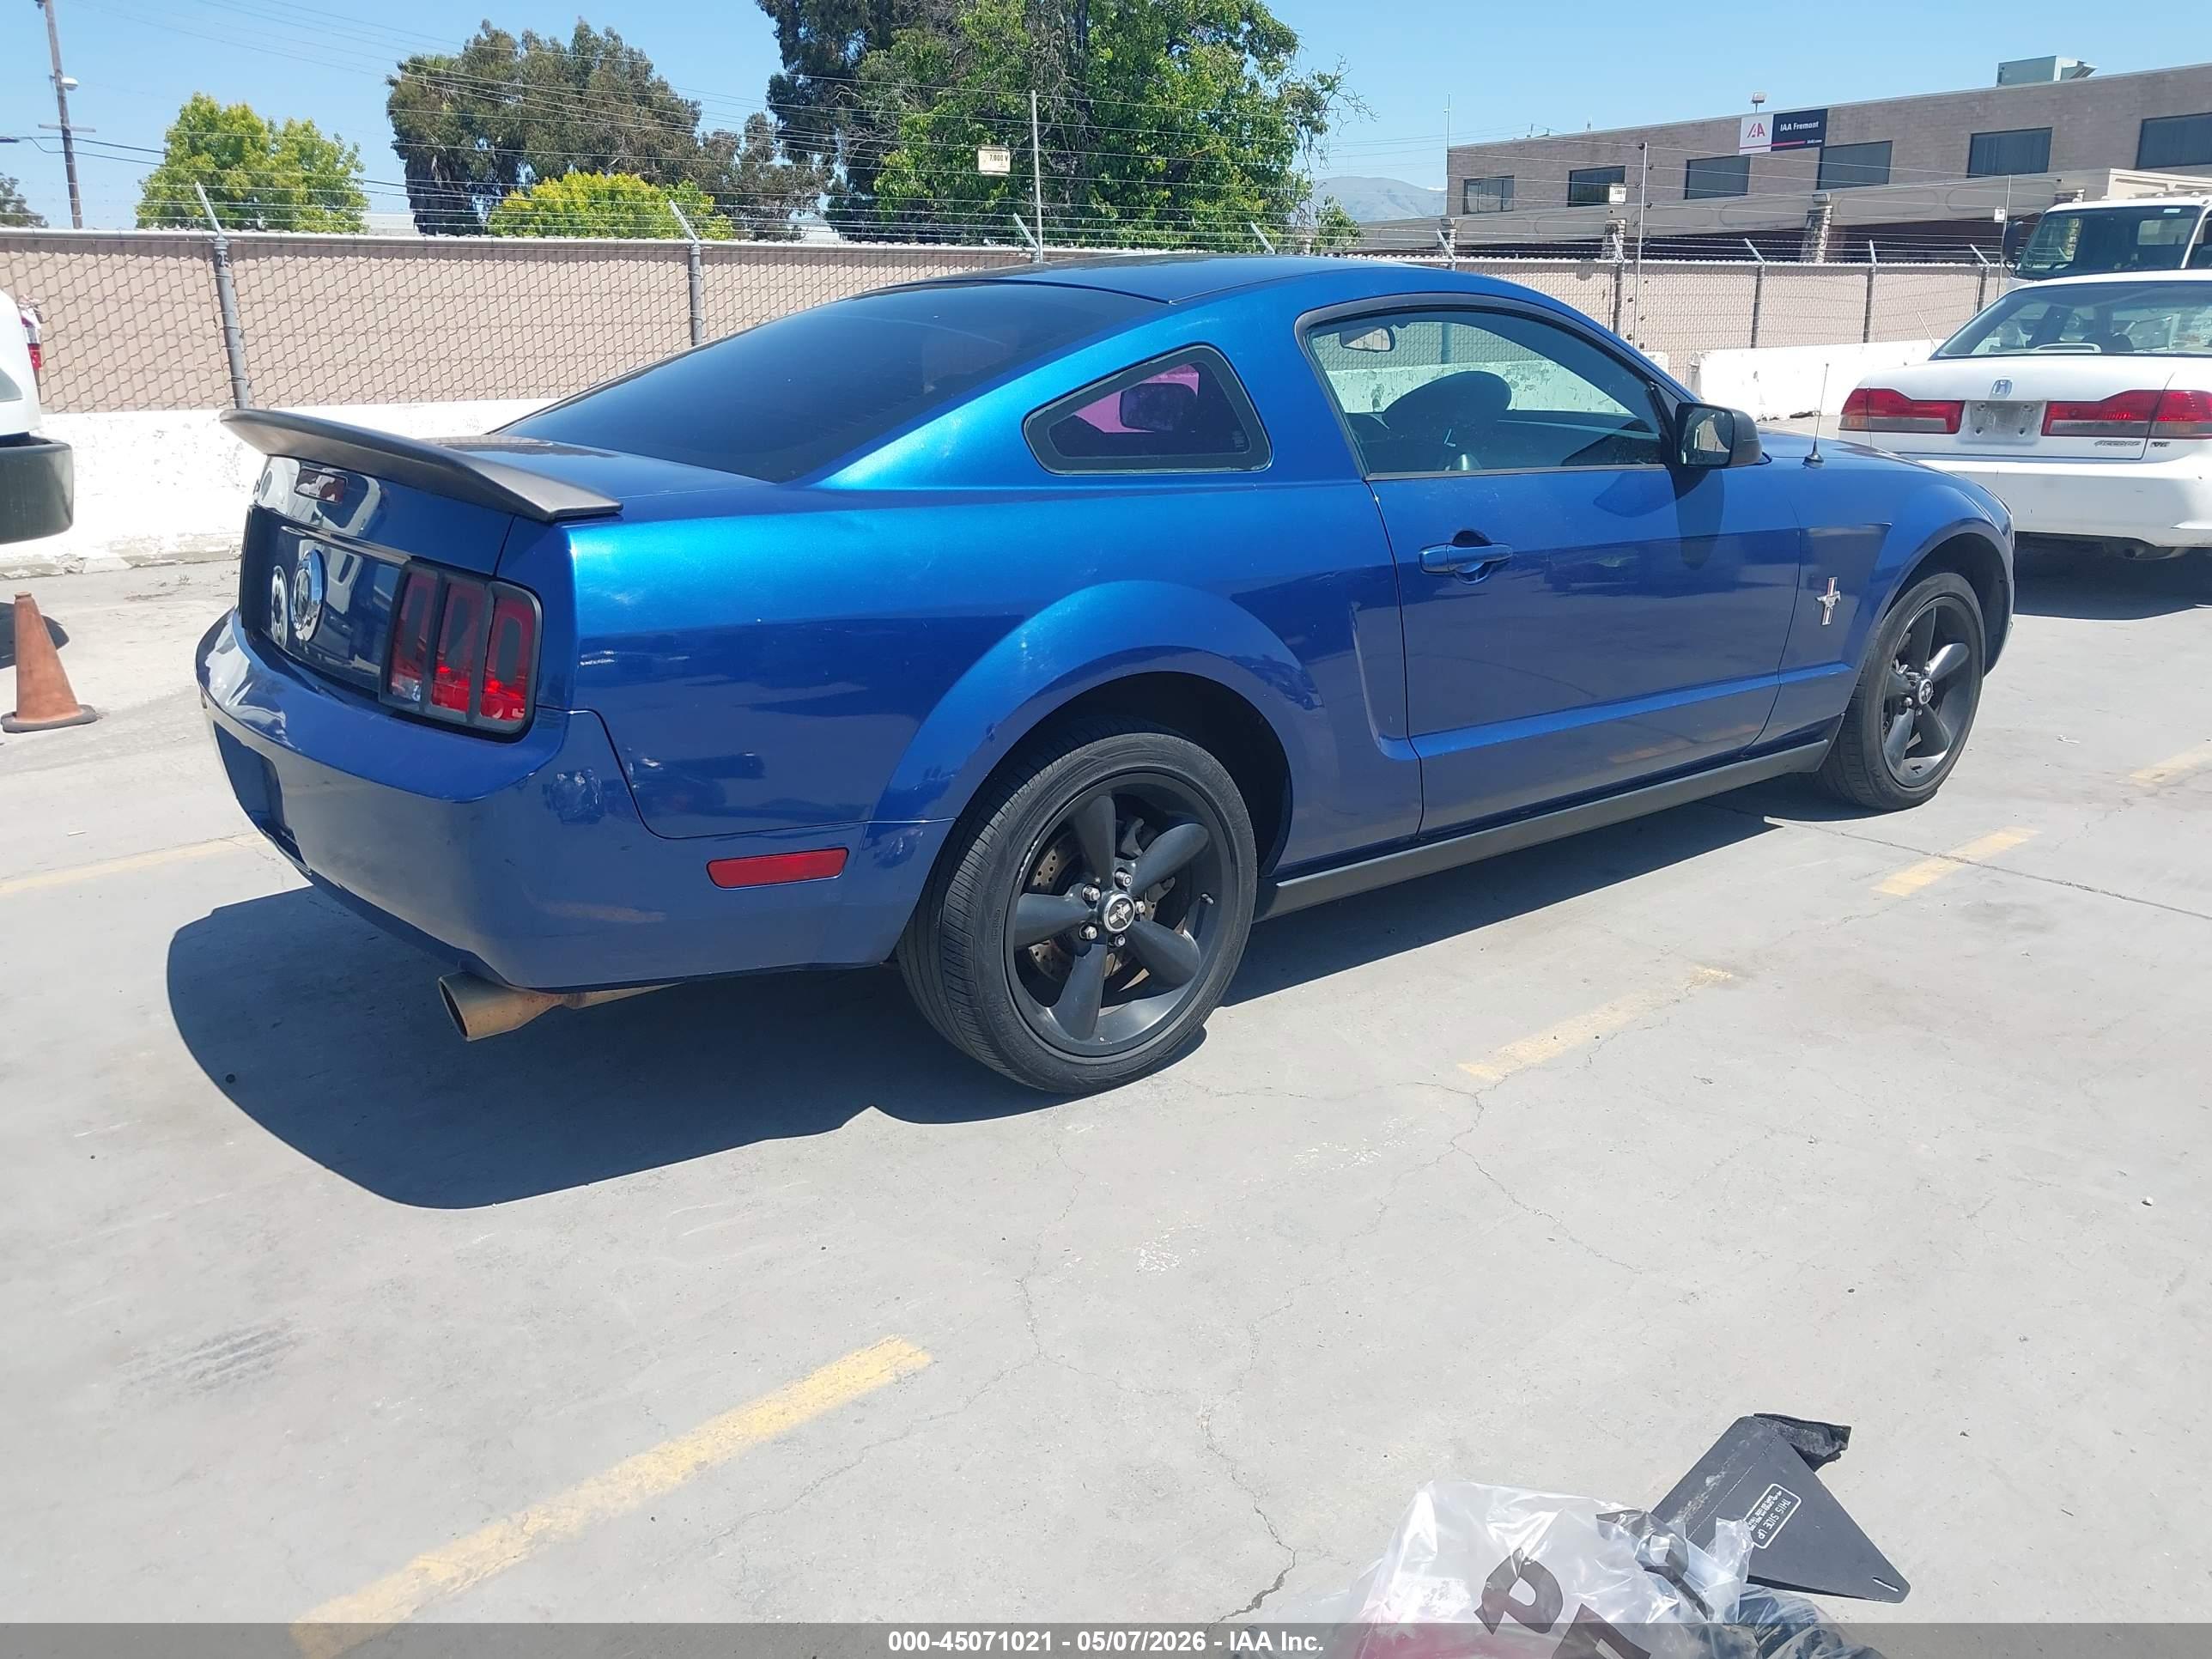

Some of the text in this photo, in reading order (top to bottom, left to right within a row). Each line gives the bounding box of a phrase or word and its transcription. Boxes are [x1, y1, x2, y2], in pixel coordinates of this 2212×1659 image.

[1793, 122, 1819, 131] Fremont
[1774, 1498, 1792, 1515] THIS
[1762, 1512, 1780, 1530] SIDE
[1757, 1528, 1768, 1540] UP
